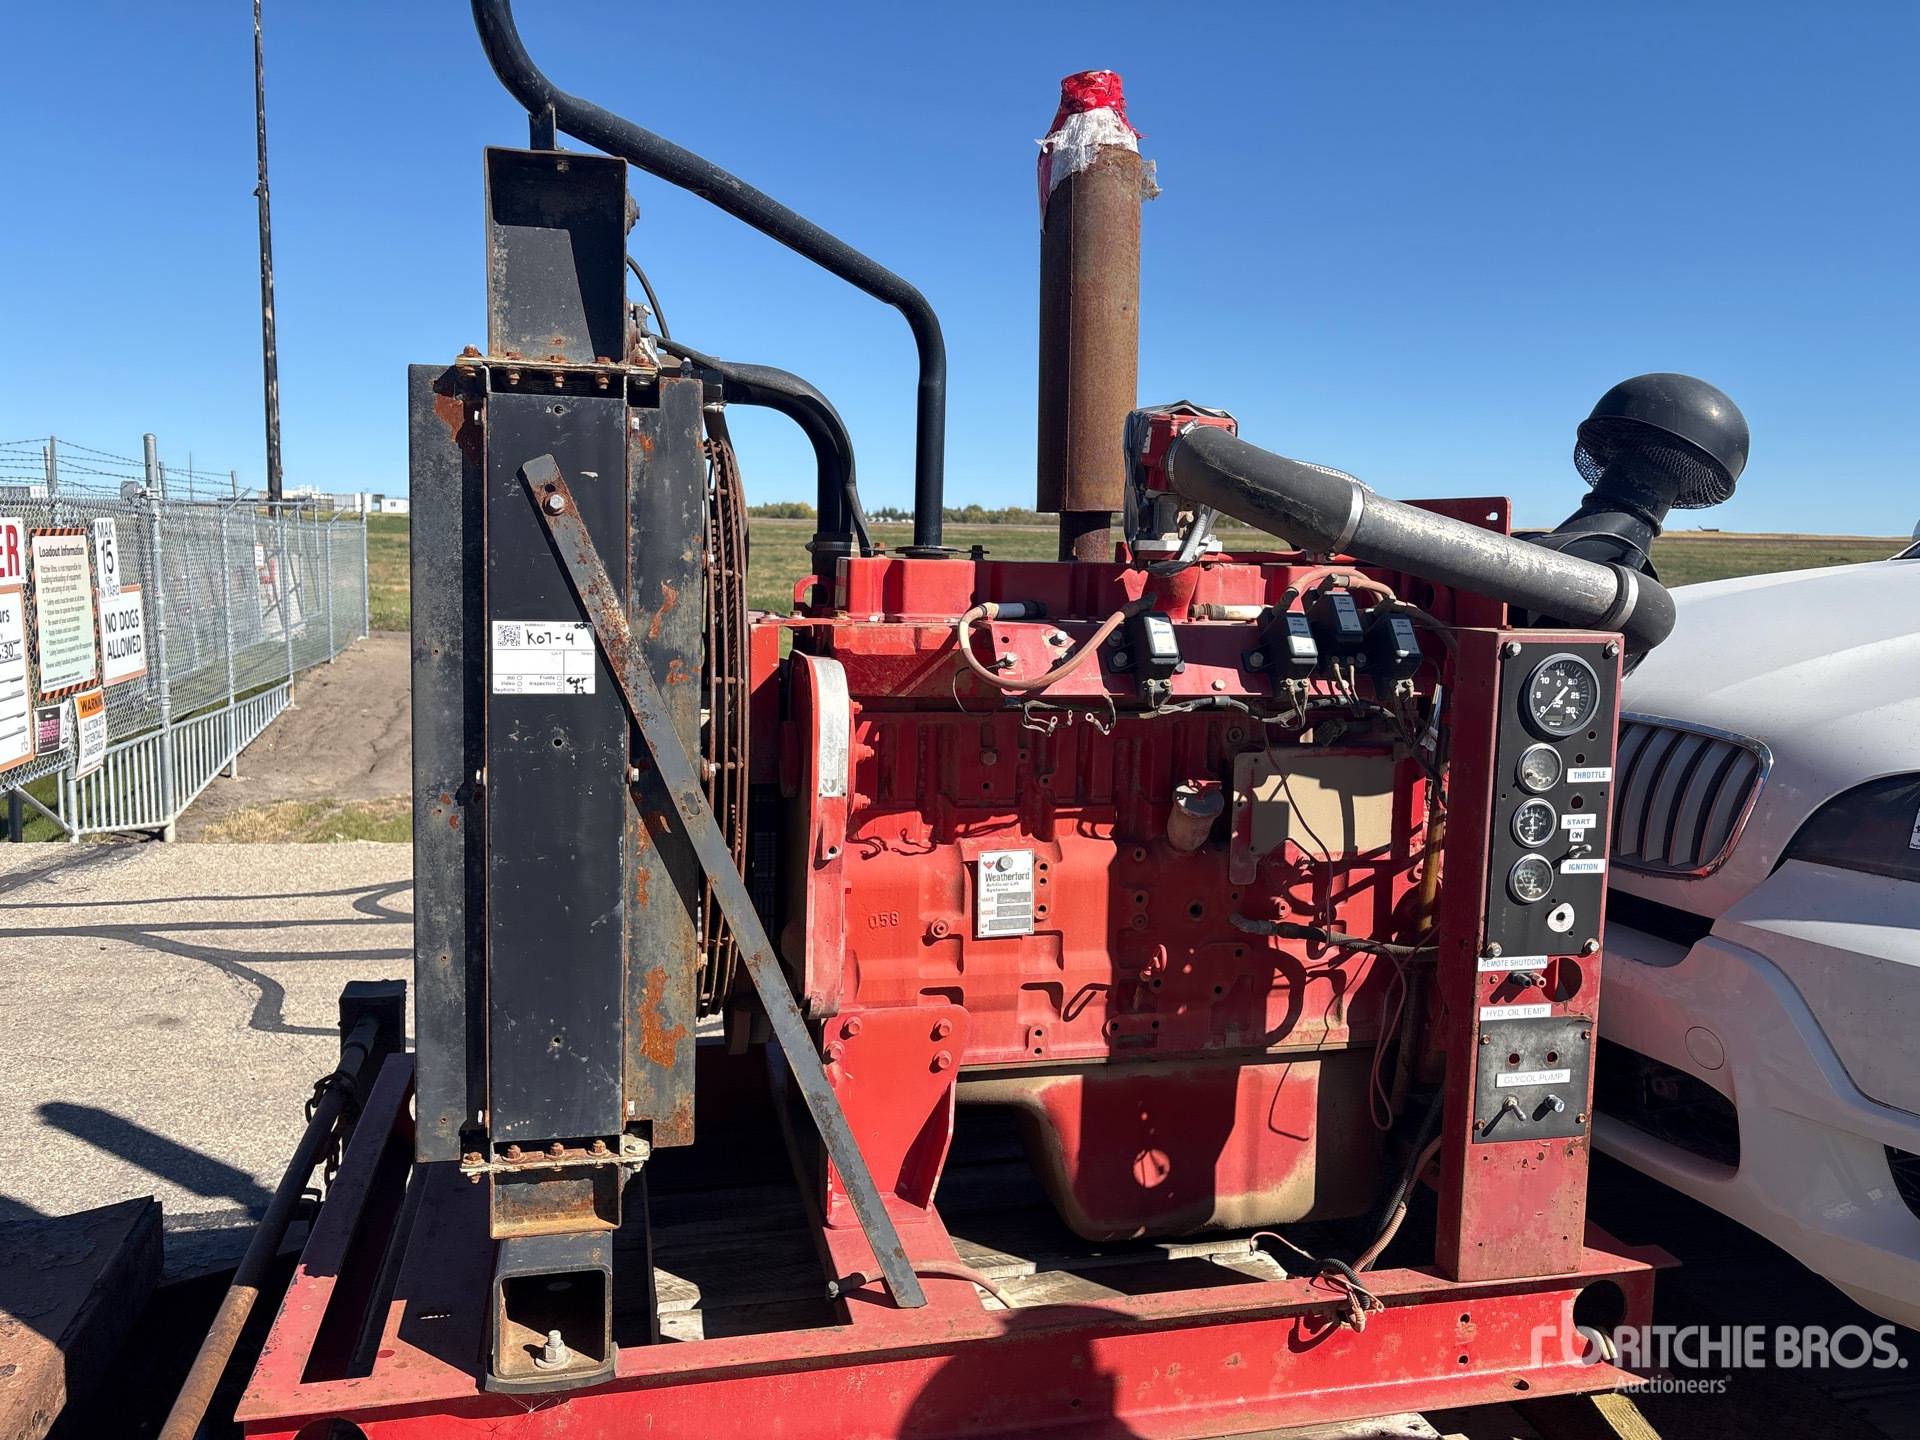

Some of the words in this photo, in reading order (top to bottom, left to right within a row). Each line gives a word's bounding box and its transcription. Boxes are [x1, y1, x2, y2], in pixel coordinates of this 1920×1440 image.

[39, 545, 60, 558] Loadout
[61, 544, 84, 556] Information
[101, 539, 115, 574] 15
[101, 586, 106, 598] IN
[107, 584, 119, 597] YARD
[104, 612, 117, 634] NO
[119, 608, 140, 631] DOGS
[106, 634, 142, 661] ALLOWED
[1570, 691, 1580, 699] 25
[1565, 706, 1576, 714] 30
[1573, 770, 1606, 779] THROTTLE
[1572, 831, 1582, 839] ON
[1568, 863, 1598, 871] IGNITION
[985, 871, 1030, 882] Weatherford
[1482, 959, 1508, 968] REMOTE
[1510, 957, 1547, 966] SHUTDOWN
[1507, 1008, 1520, 1016] OIL
[1523, 1006, 1546, 1016] TEMP
[1504, 1074, 1538, 1084] GLYCOL
[1538, 1072, 1564, 1083] PUMP
